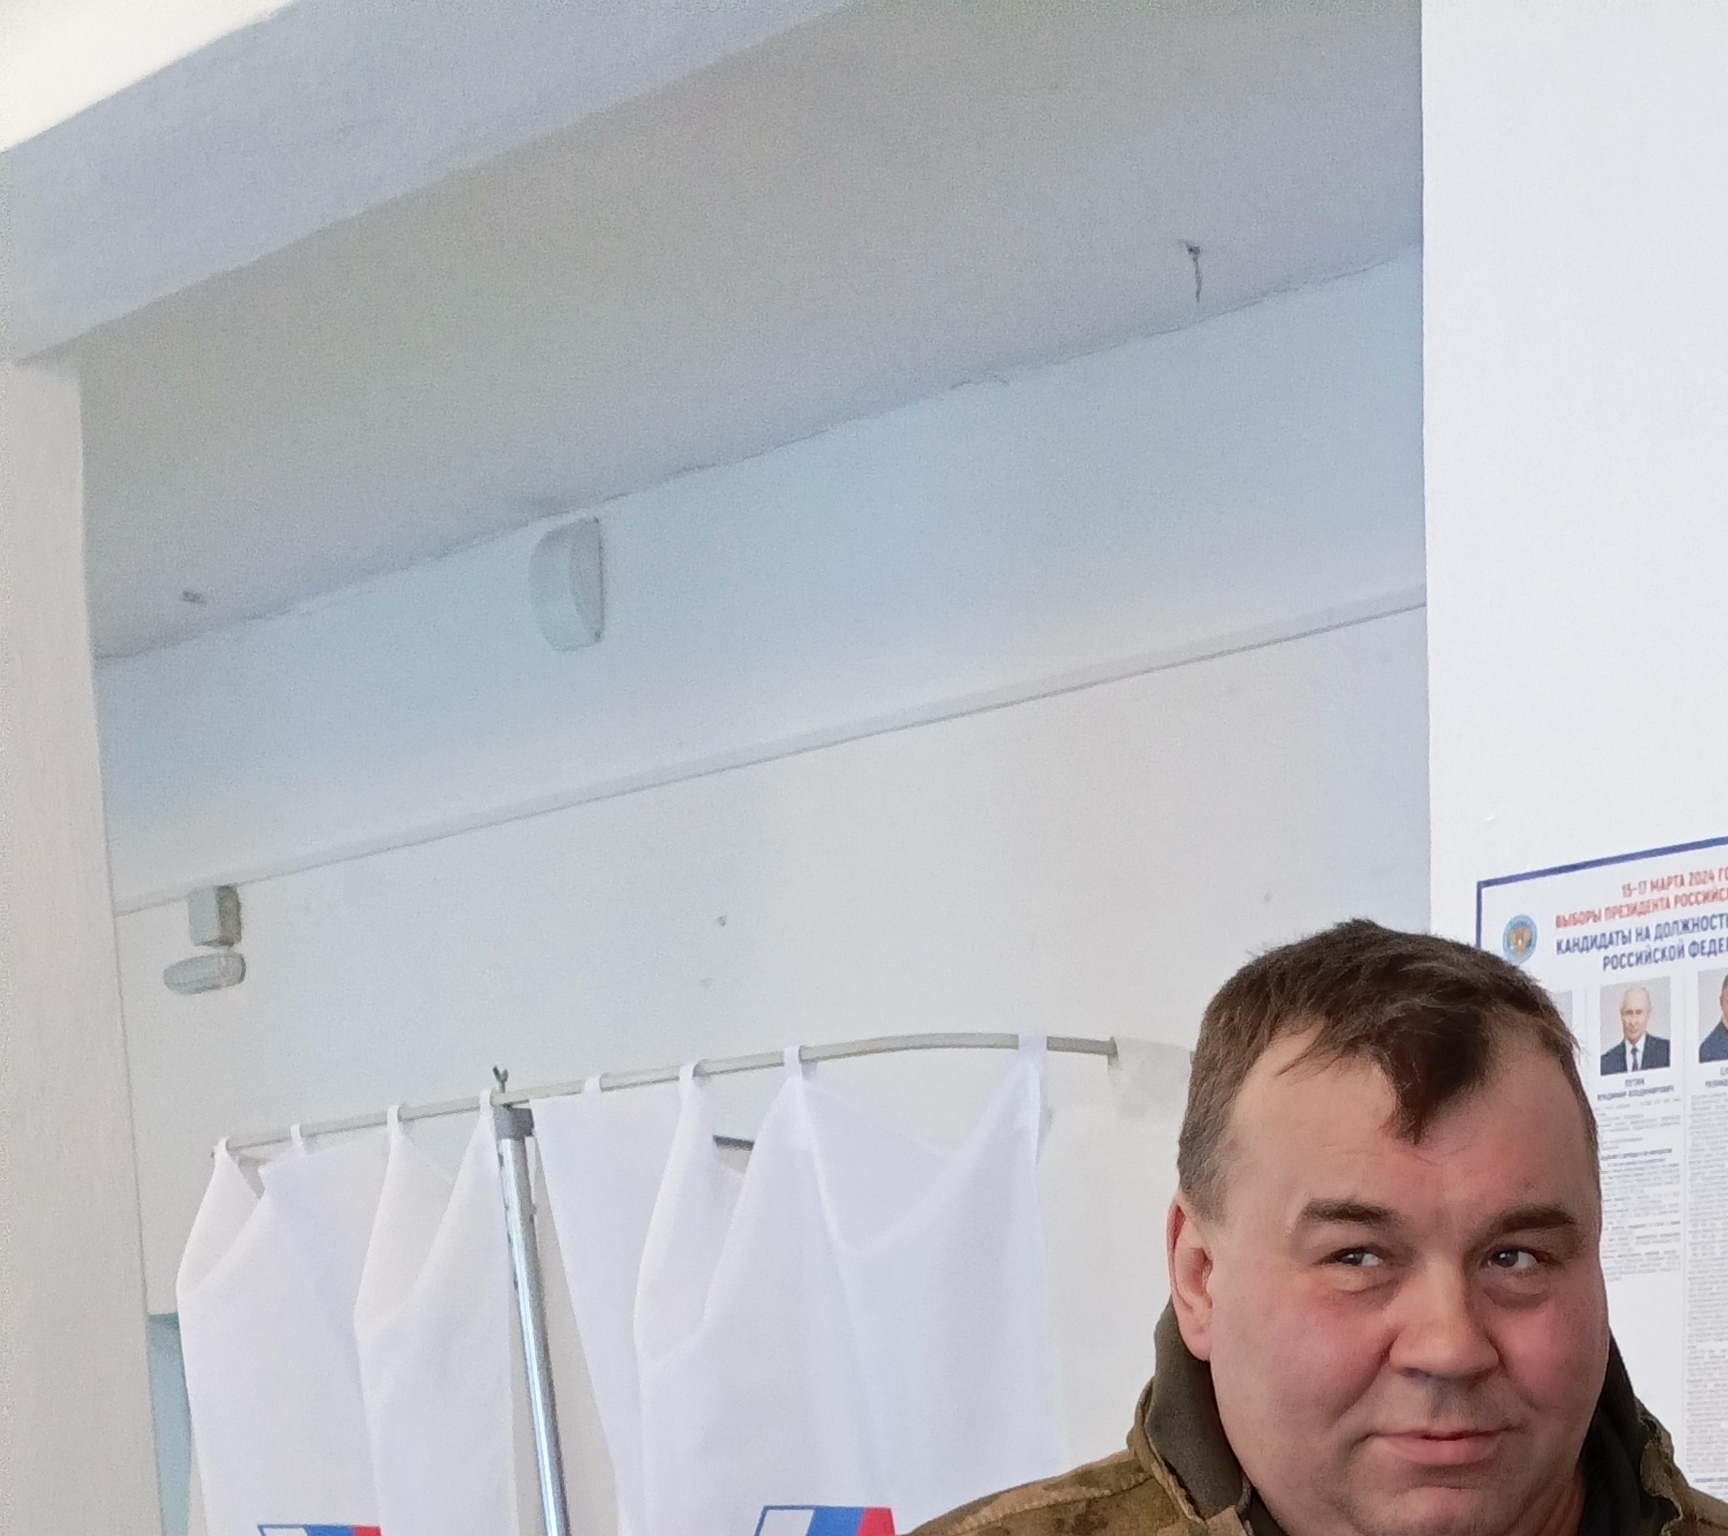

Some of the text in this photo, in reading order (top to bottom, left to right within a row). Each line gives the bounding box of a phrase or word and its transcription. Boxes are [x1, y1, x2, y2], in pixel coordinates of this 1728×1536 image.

[1650, 874, 1685, 892] МАРТА
[1555, 908, 1602, 929] ВЫБОРЫ
[1604, 898, 1671, 921] ПРЕЗИДЕНТА
[1556, 928, 1632, 955] КАНДИДАТЫ
[1635, 926, 1650, 943] НА
[1602, 940, 1686, 971] РОССИЙСКОЙ
